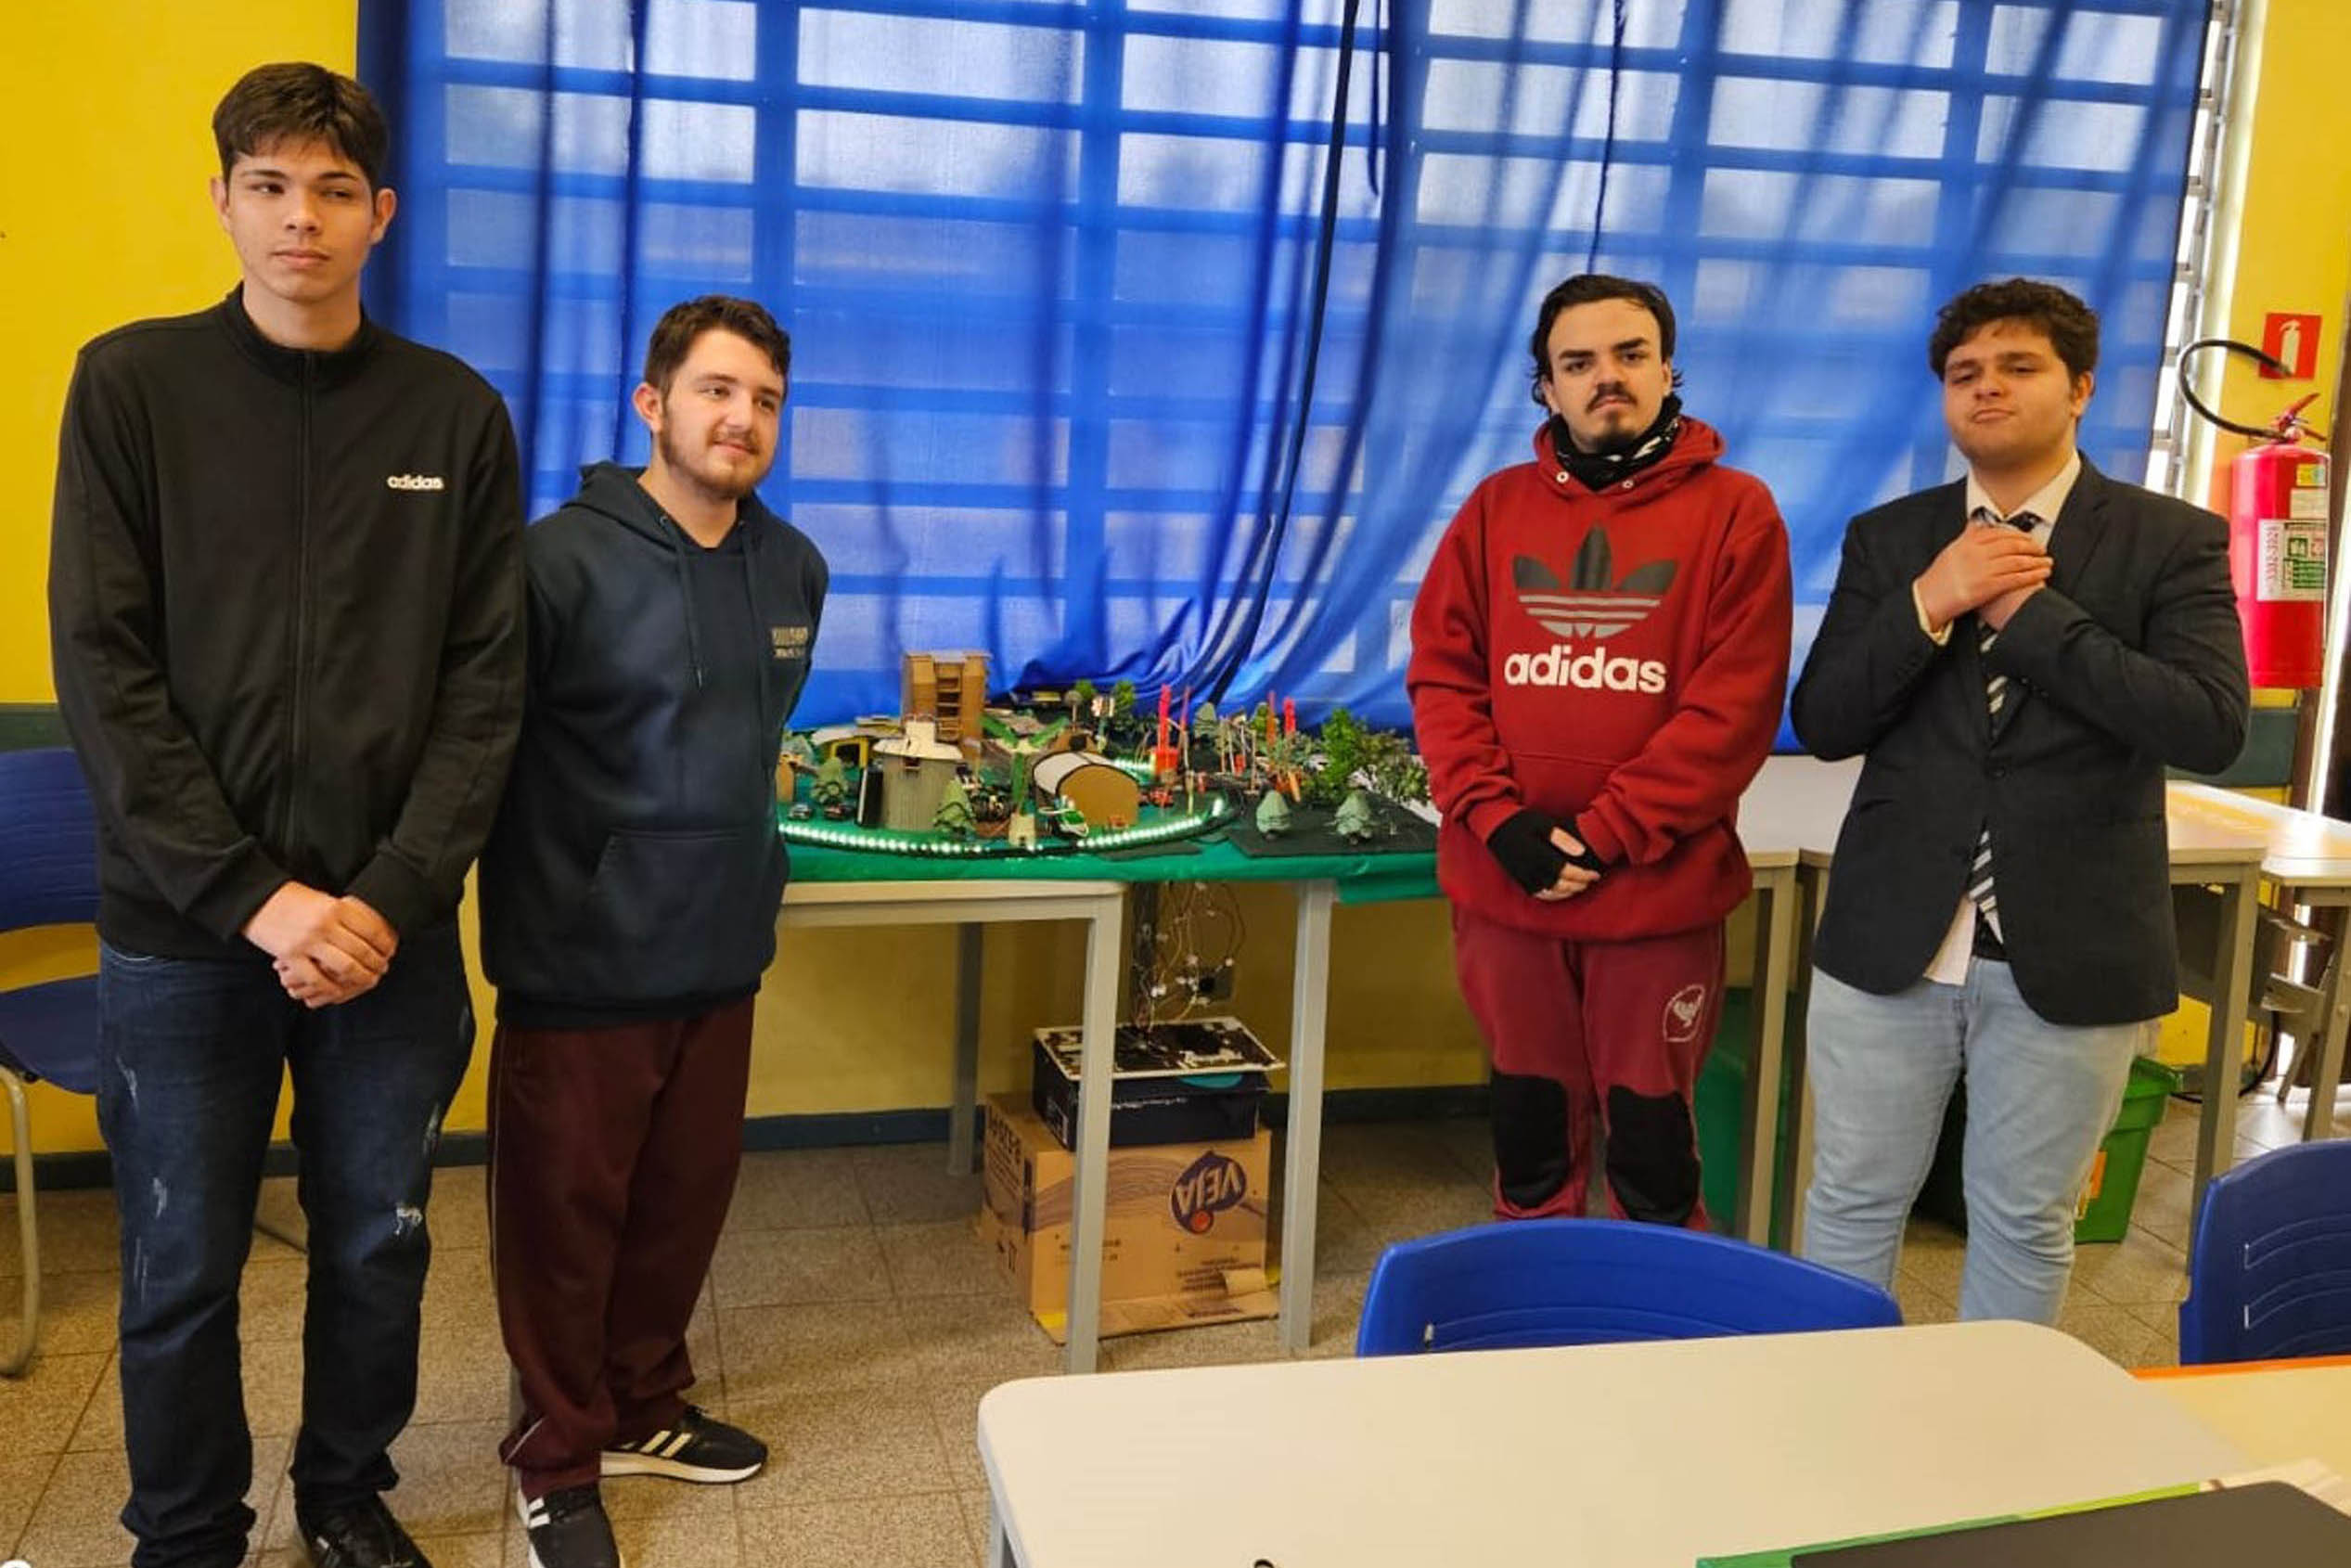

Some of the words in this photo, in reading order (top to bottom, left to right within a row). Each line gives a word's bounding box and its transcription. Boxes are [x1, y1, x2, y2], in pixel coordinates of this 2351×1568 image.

[387, 474, 444, 491] adidas
[1504, 644, 1667, 694] adidas
[1176, 1162, 1241, 1215] VEJA
